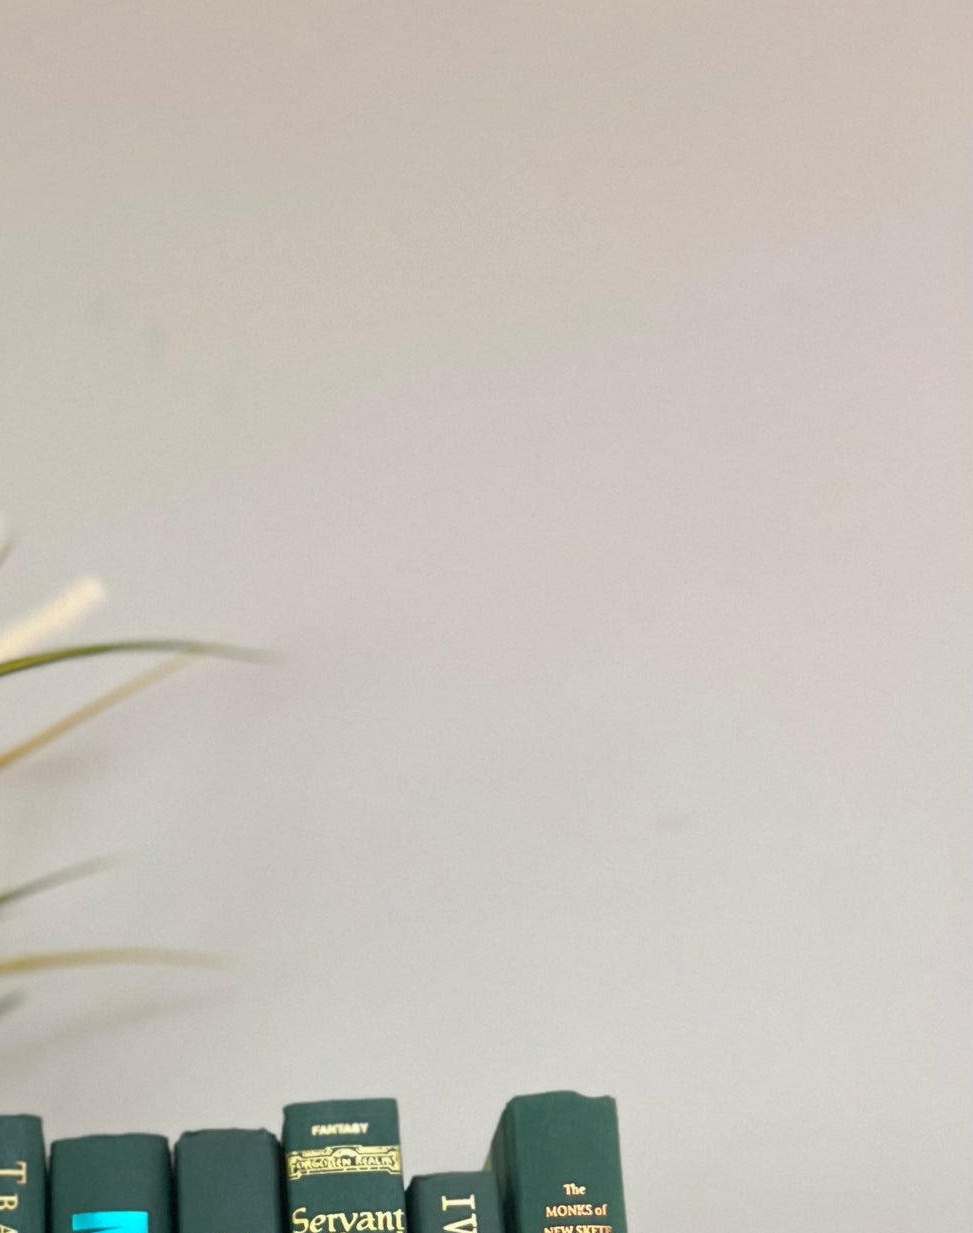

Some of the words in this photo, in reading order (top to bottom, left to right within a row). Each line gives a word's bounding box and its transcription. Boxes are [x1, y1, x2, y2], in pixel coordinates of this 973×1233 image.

[563, 1183, 586, 1195] The
[546, 1204, 593, 1218] MONKS
[594, 1204, 607, 1216] of
